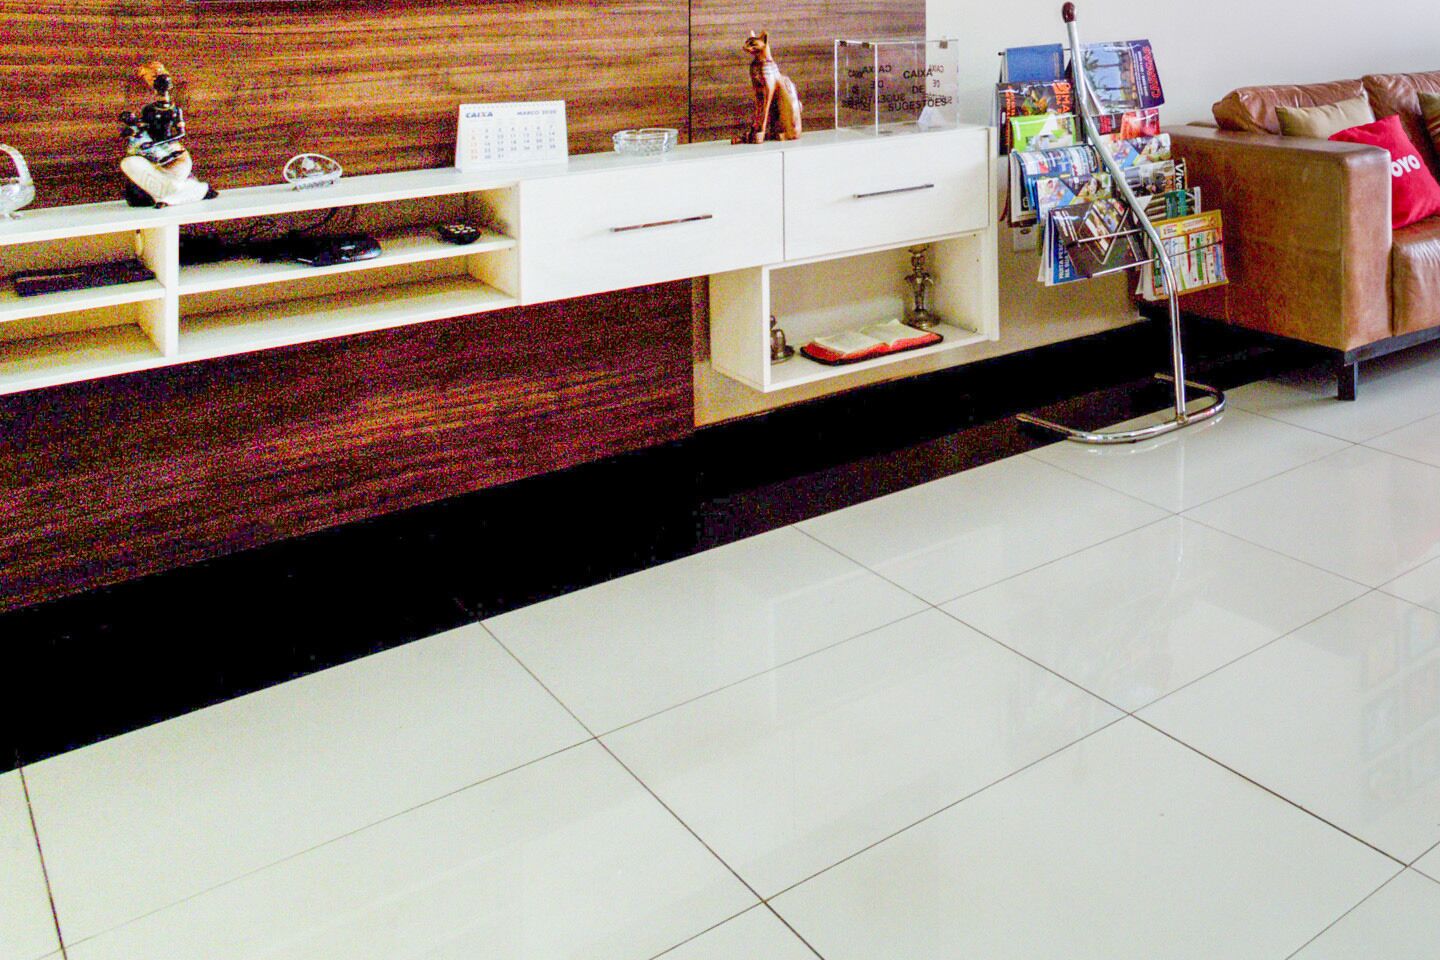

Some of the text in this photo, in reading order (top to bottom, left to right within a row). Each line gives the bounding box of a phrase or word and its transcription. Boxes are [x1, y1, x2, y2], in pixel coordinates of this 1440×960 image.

[902, 67, 933, 79] CAIXA
[912, 85, 926, 94] DE
[1390, 154, 1421, 179] OYO
[1175, 163, 1184, 191] Vive
